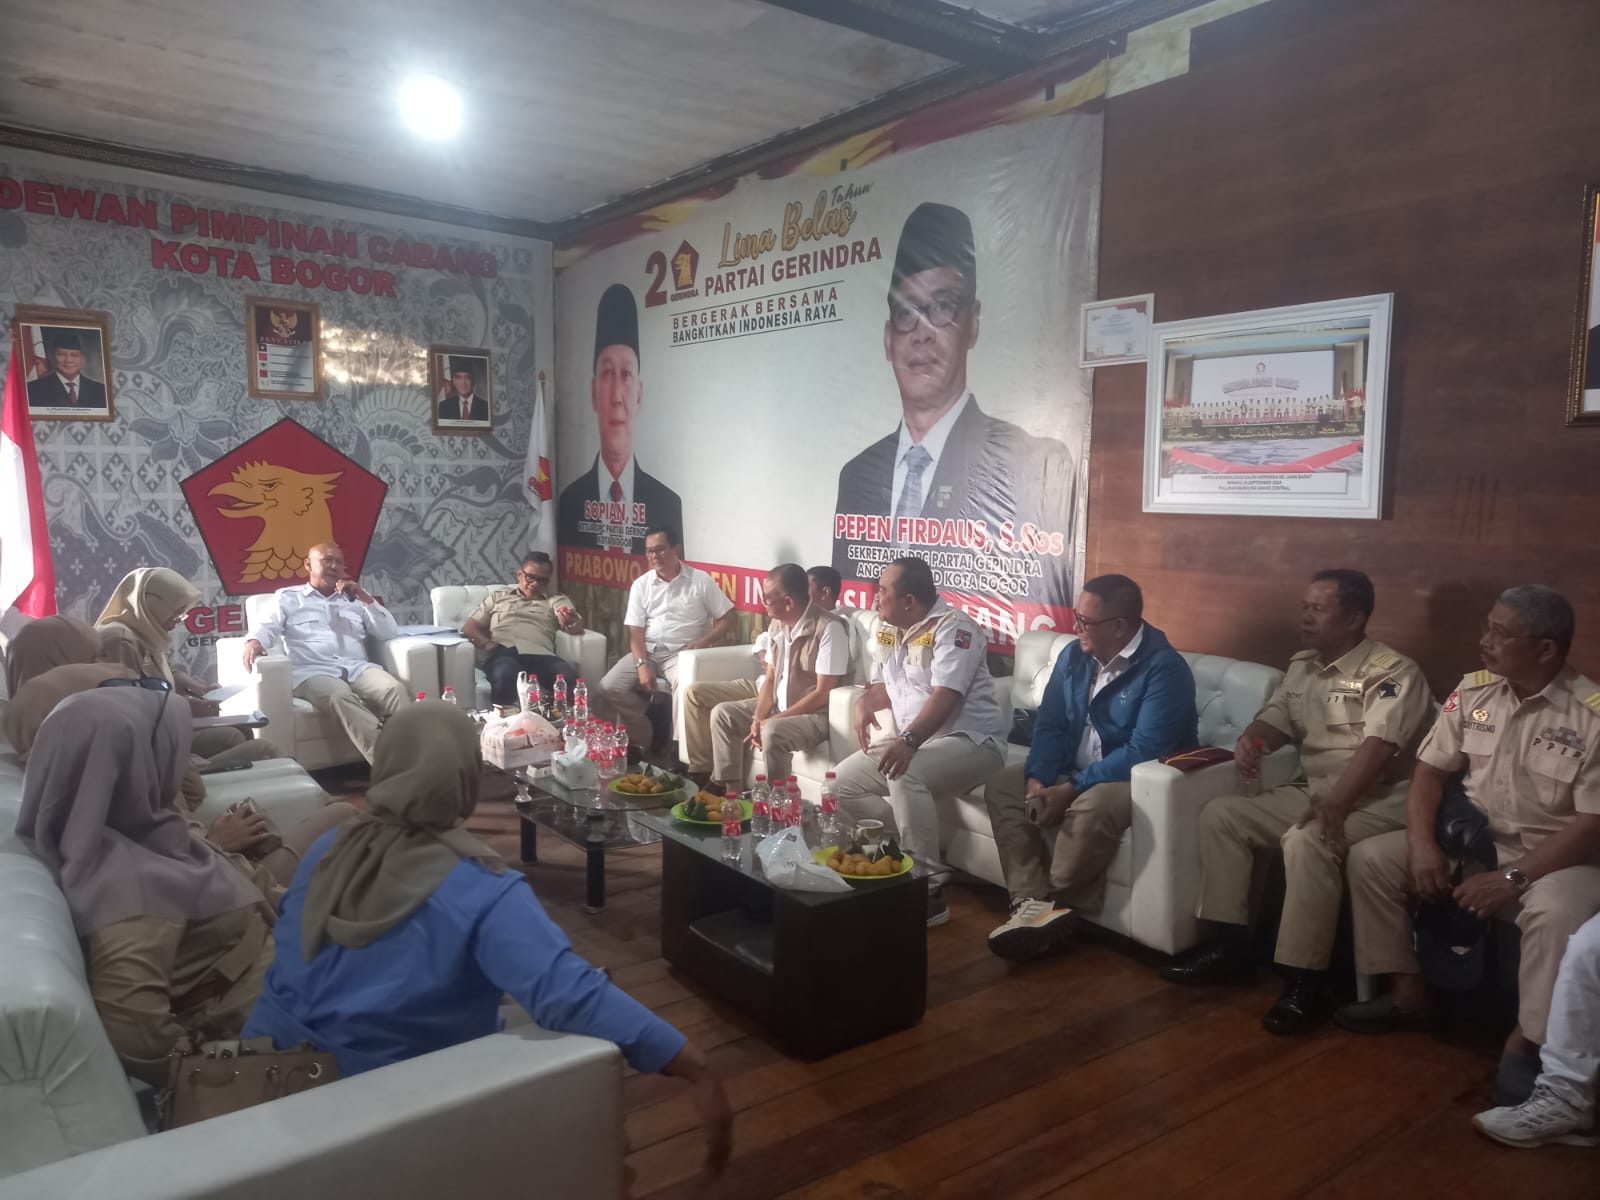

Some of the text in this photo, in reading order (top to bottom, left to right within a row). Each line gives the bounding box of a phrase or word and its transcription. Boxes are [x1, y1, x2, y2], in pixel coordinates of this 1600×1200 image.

[831, 181, 874, 206] Tahun
[0, 176, 497, 279] DEWAN PIMPINAN CABANG
[718, 189, 857, 269] Lima Belas
[151, 239, 397, 298] KOTA BOGOR
[704, 237, 882, 297] PARTAI GERINDRA
[672, 303, 837, 343] BANGKITKAN INDONESIA RAYA
[673, 286, 838, 330] BERGERAK BERSAMA
[584, 500, 646, 524] SOPIAN, SE
[835, 514, 891, 542] PEPEN
[897, 517, 992, 553] FIRDAUS,
[566, 551, 643, 583] PRABOWO
[848, 545, 905, 562] SEKRETARIS
[931, 551, 972, 570] PARTAI
[974, 555, 1042, 577] GERINDRA
[944, 570, 977, 589] KOTA
[980, 575, 1029, 597] BOGOR
